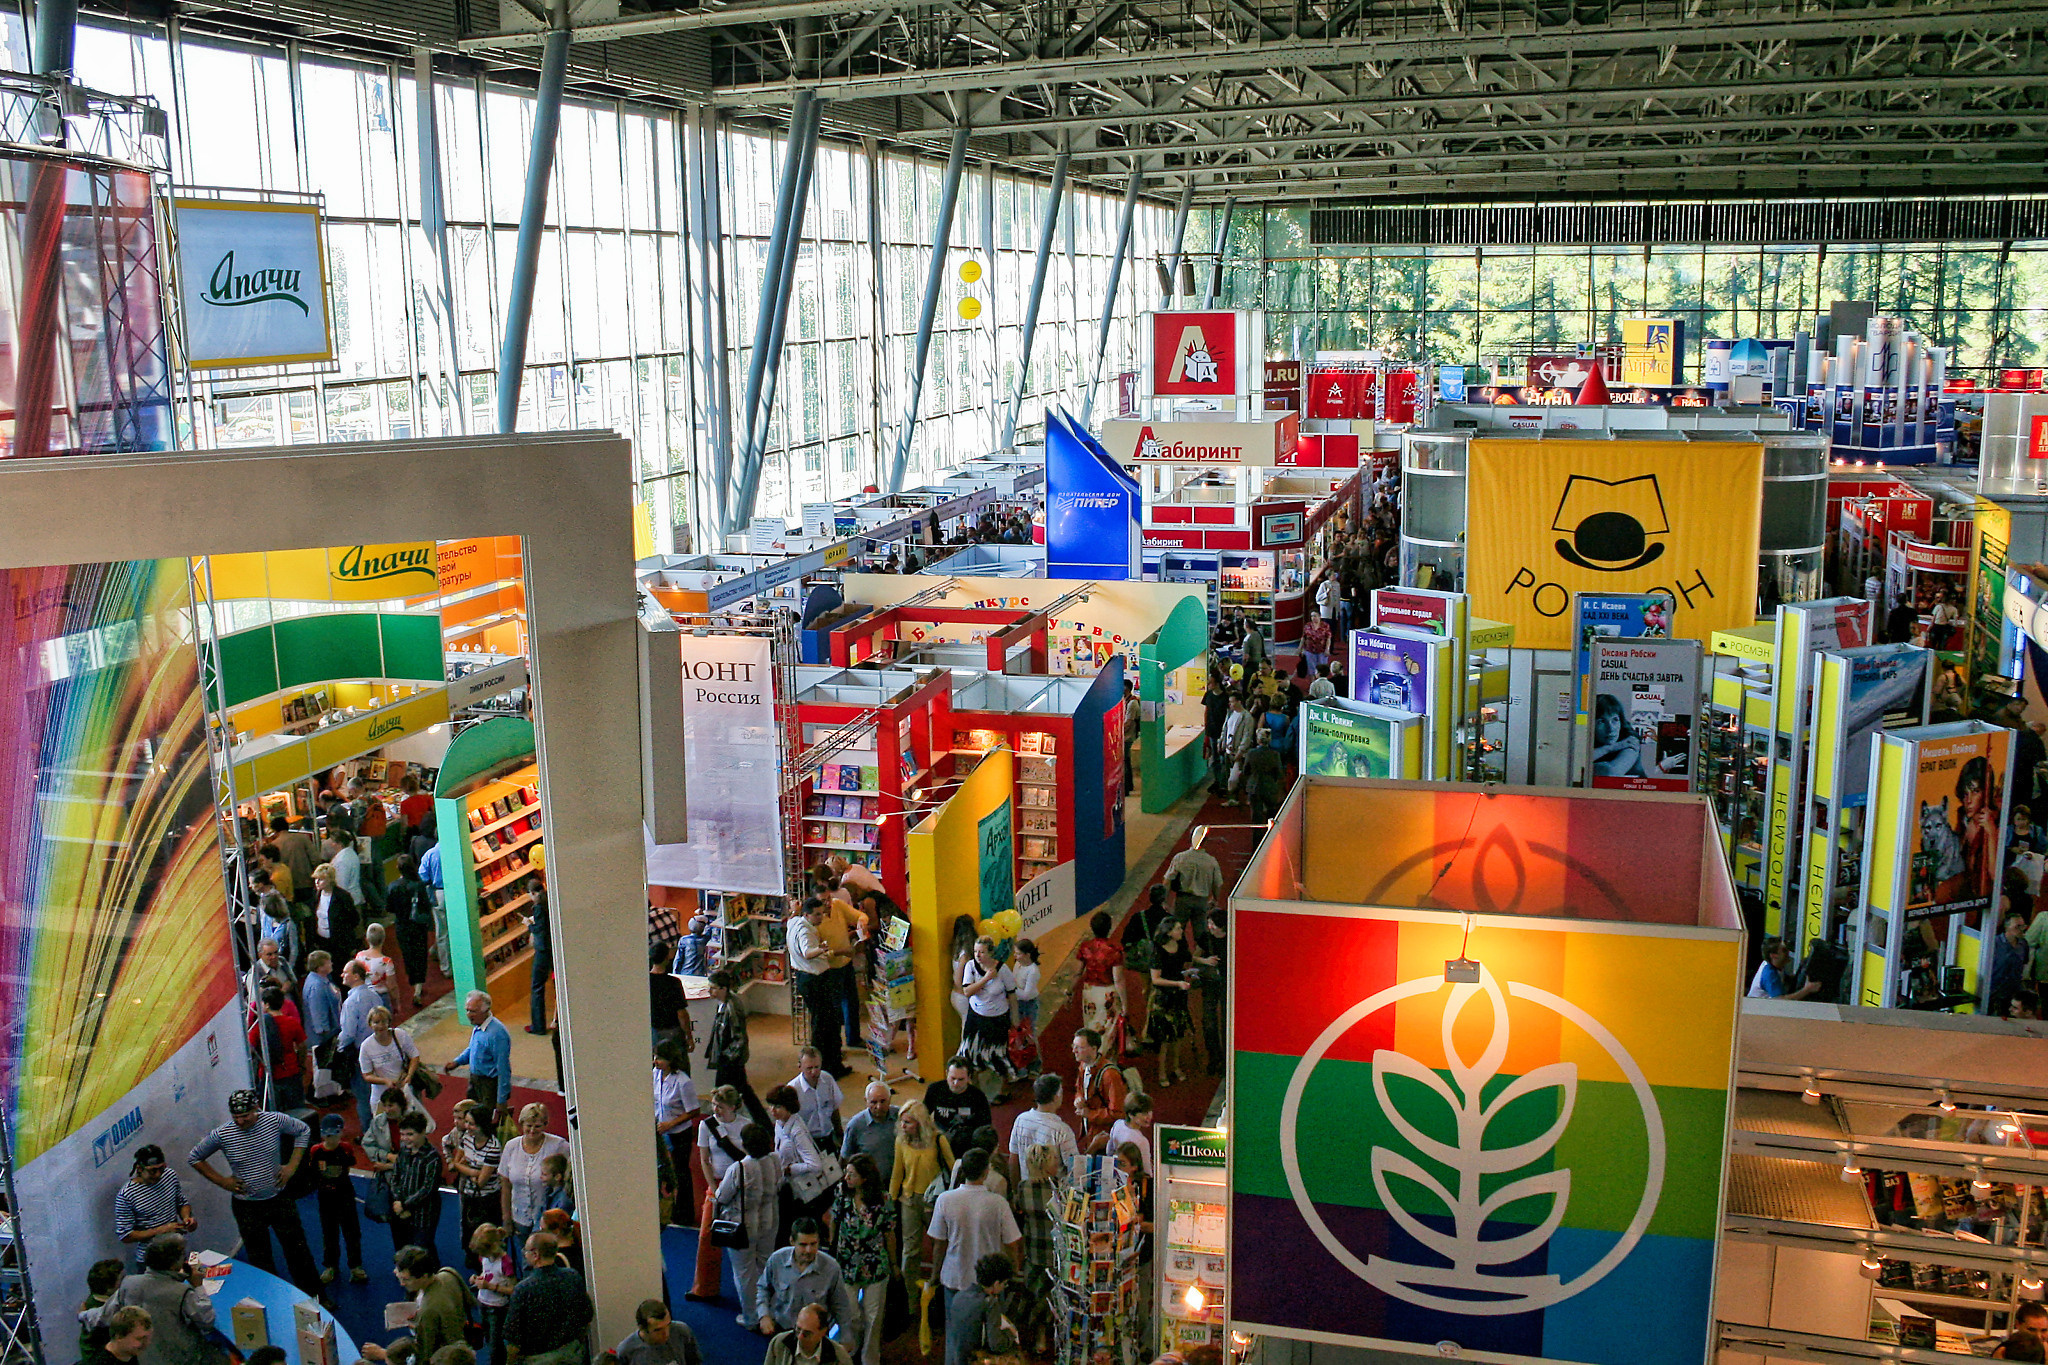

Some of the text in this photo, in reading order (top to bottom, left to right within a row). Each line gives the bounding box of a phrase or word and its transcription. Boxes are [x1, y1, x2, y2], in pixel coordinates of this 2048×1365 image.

[201, 251, 309, 316] Апачи
[1625, 360, 1669, 376] Айрис
[1073, 498, 1119, 508] ПИТЕР
[1142, 537, 1184, 547] абиринт
[331, 545, 436, 581] Апачи
[1378, 604, 1433, 619] Чернильное сердце
[1583, 611, 1597, 620] САД
[1611, 612, 1629, 621] ВЕКА
[1357, 636, 1369, 647] Ева
[1472, 632, 1509, 644] РОСМЭН
[1601, 648, 1656, 657] Оксана Робски
[1730, 642, 1770, 658] РОСМЭН
[1601, 660, 1628, 668] CASUAL
[1600, 672, 1683, 682] ДЕНЬ СЧАСТЬЯ ЗАВТРА
[696, 688, 761, 705] Россия
[1331, 714, 1354, 727] Ролинг
[1309, 723, 1370, 745] Принц-полукровка
[1920, 761, 1937, 773] БРАТ
[1771, 791, 1788, 889] РОСМЭН
[1807, 864, 1825, 938] СМЭН
[1181, 1145, 1225, 1157] Школь
